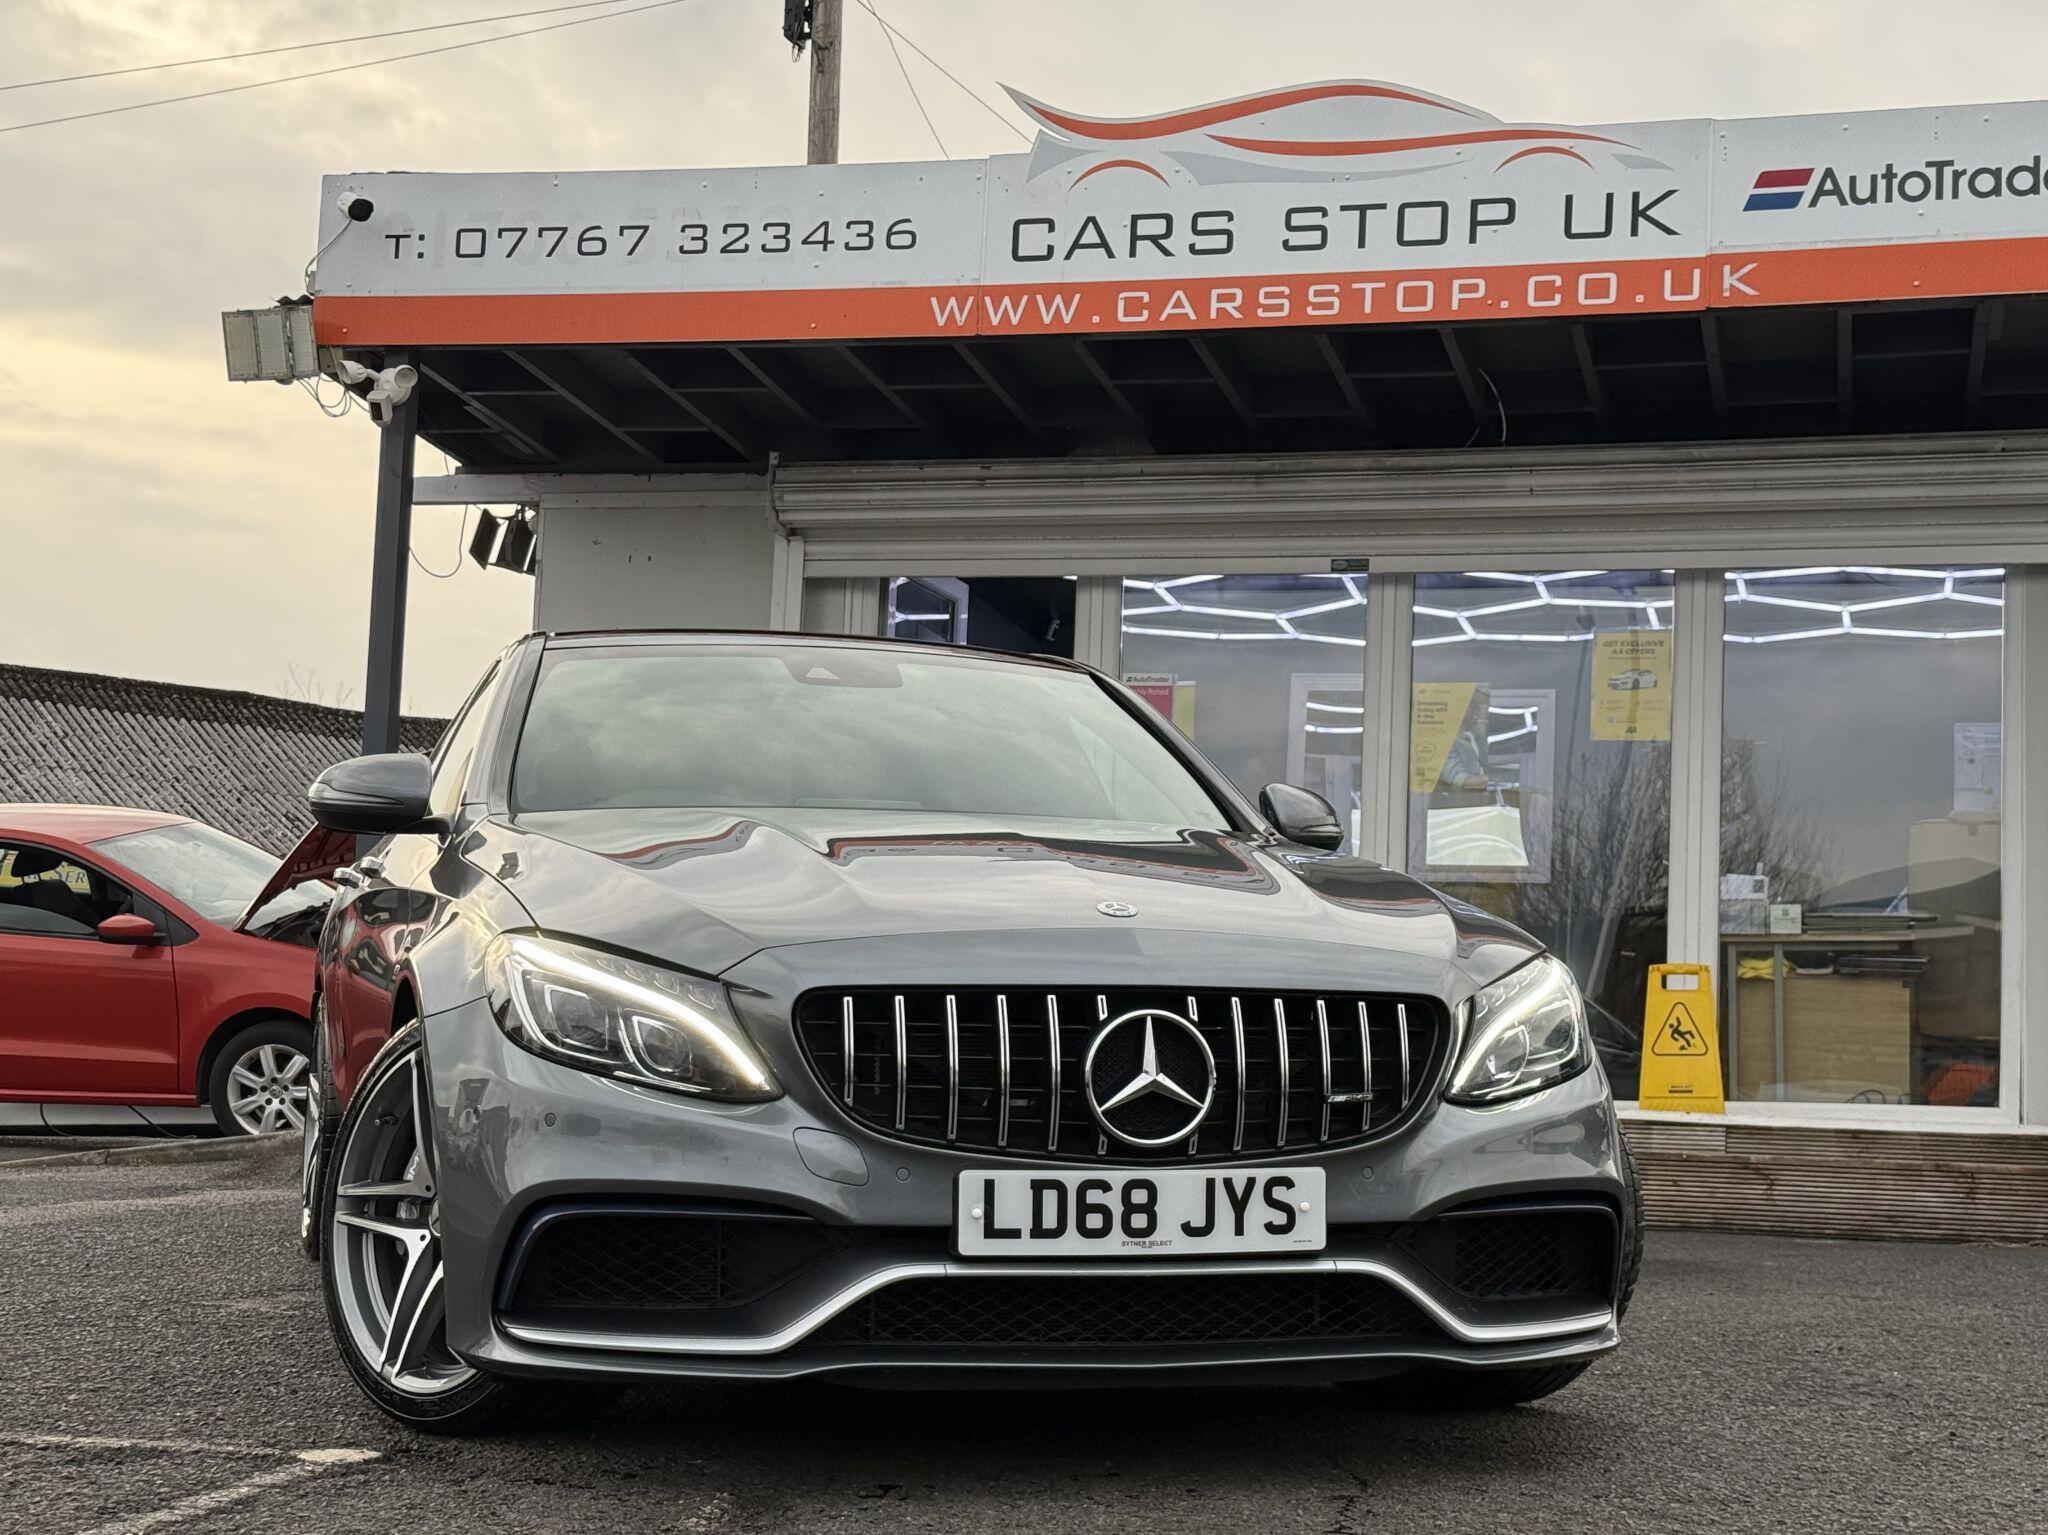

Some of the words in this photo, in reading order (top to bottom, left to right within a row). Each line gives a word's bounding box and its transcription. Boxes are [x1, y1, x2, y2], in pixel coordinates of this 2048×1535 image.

[1808, 155, 2048, 208] AutoTrad
[384, 232, 426, 260] T:
[455, 225, 651, 259] 07767
[678, 218, 919, 257] 323436
[1011, 211, 1235, 264] CARS
[1282, 197, 1517, 252] STOP
[1564, 189, 1682, 240] UK
[929, 262, 1760, 327] WWW.CARSSTOP.CO.UK
[983, 1177, 1159, 1240] LD68
[1180, 1175, 1297, 1237] JYS
